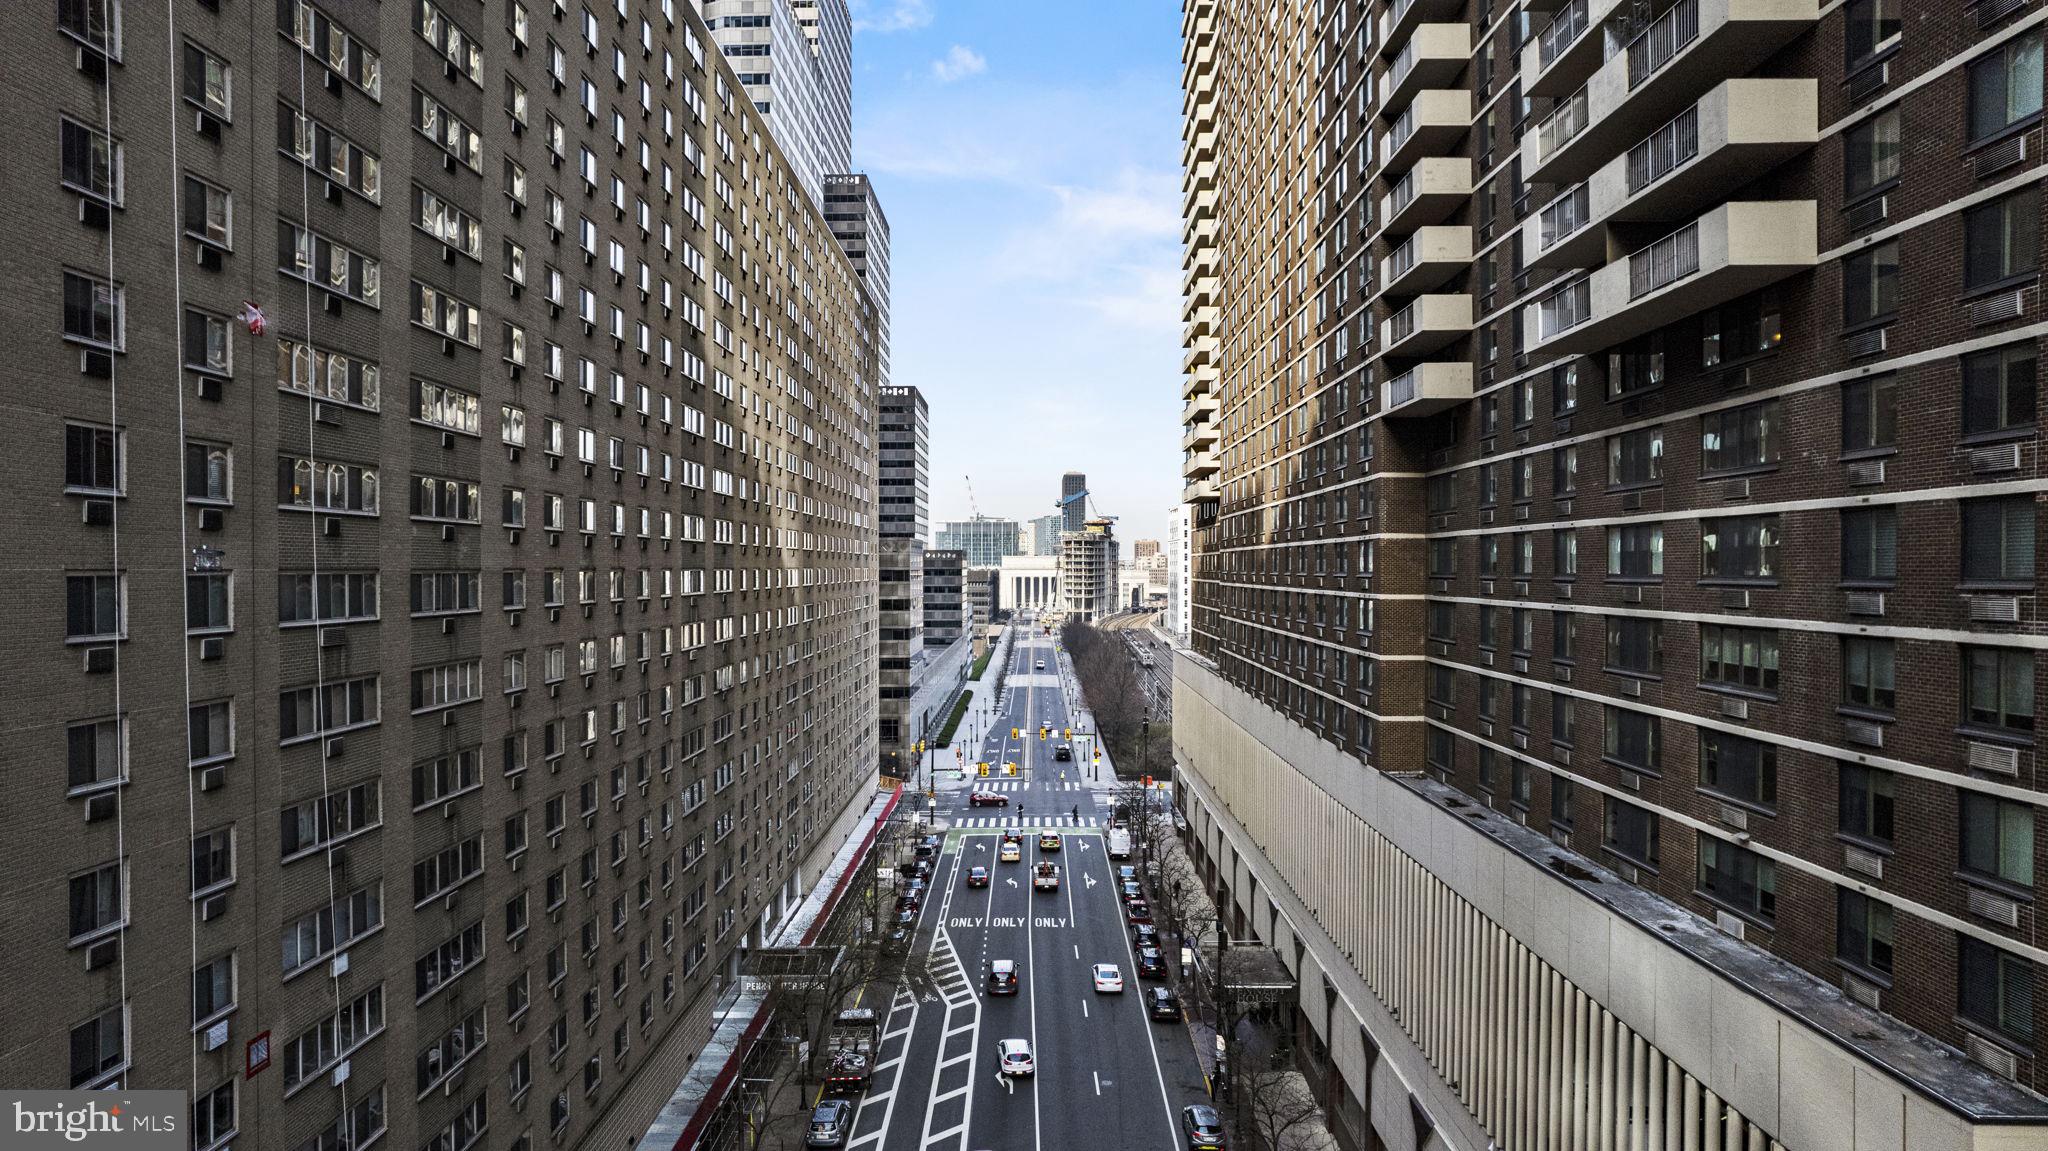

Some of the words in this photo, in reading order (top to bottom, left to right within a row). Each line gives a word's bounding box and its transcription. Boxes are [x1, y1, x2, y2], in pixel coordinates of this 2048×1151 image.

[950, 917, 983, 928] ONLY
[993, 917, 1025, 928] ONLY
[1034, 917, 1067, 928] ONLY
[1237, 994, 1278, 1003] HOUSE
